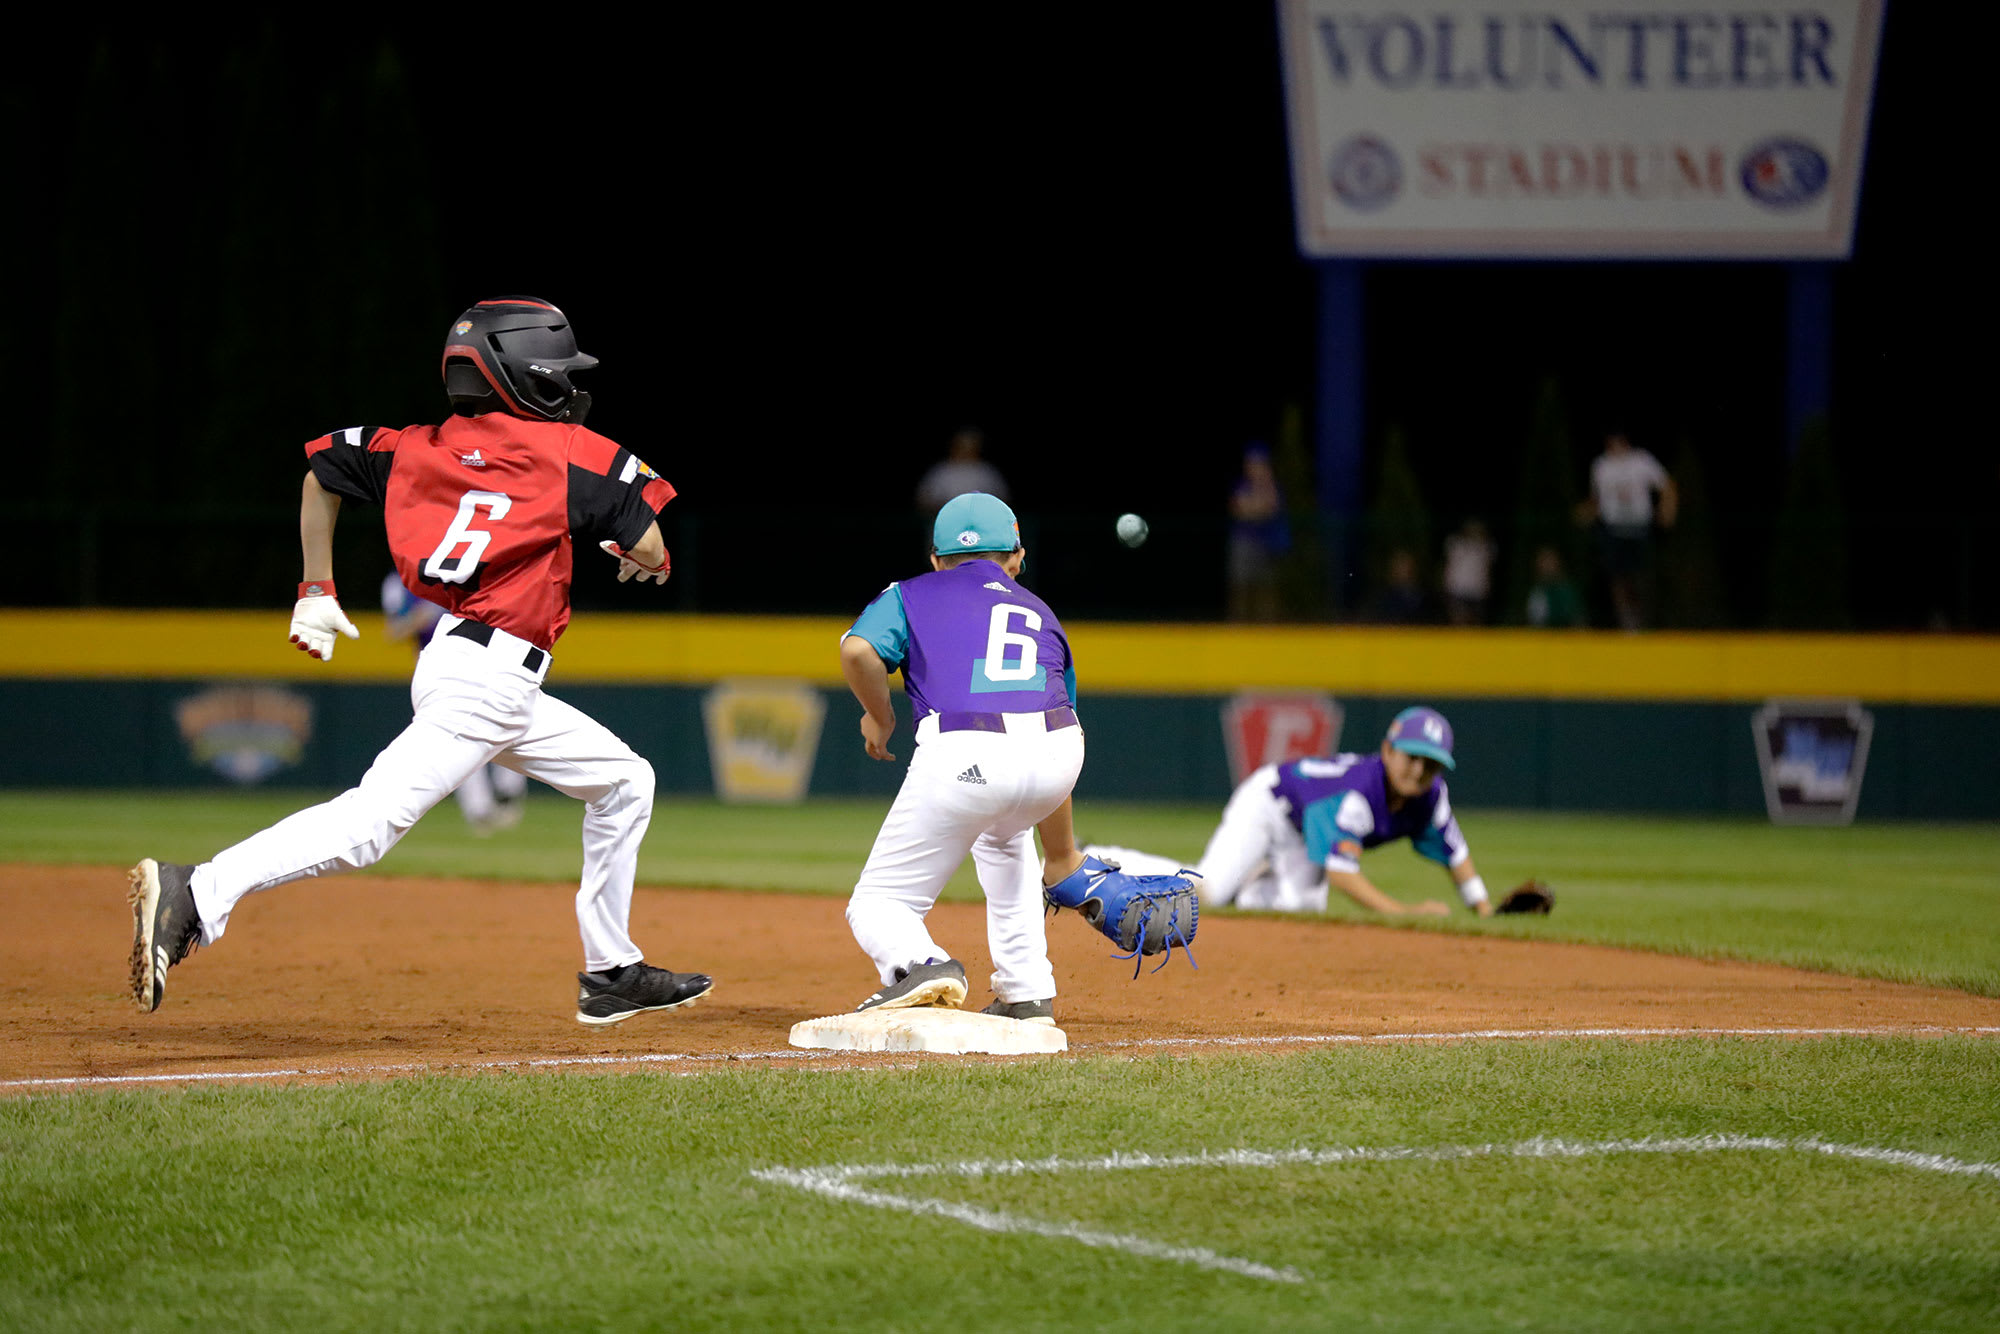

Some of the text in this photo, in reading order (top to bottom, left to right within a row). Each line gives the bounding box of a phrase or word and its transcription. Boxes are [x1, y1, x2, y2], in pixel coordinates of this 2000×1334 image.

[1317, 13, 1838, 90] VOLUNTEER
[1418, 141, 1728, 194] STADIUM
[529, 364, 553, 374] ELITE
[424, 490, 512, 584] 6
[984, 603, 1042, 681] 6
[957, 775, 987, 785] adidas
